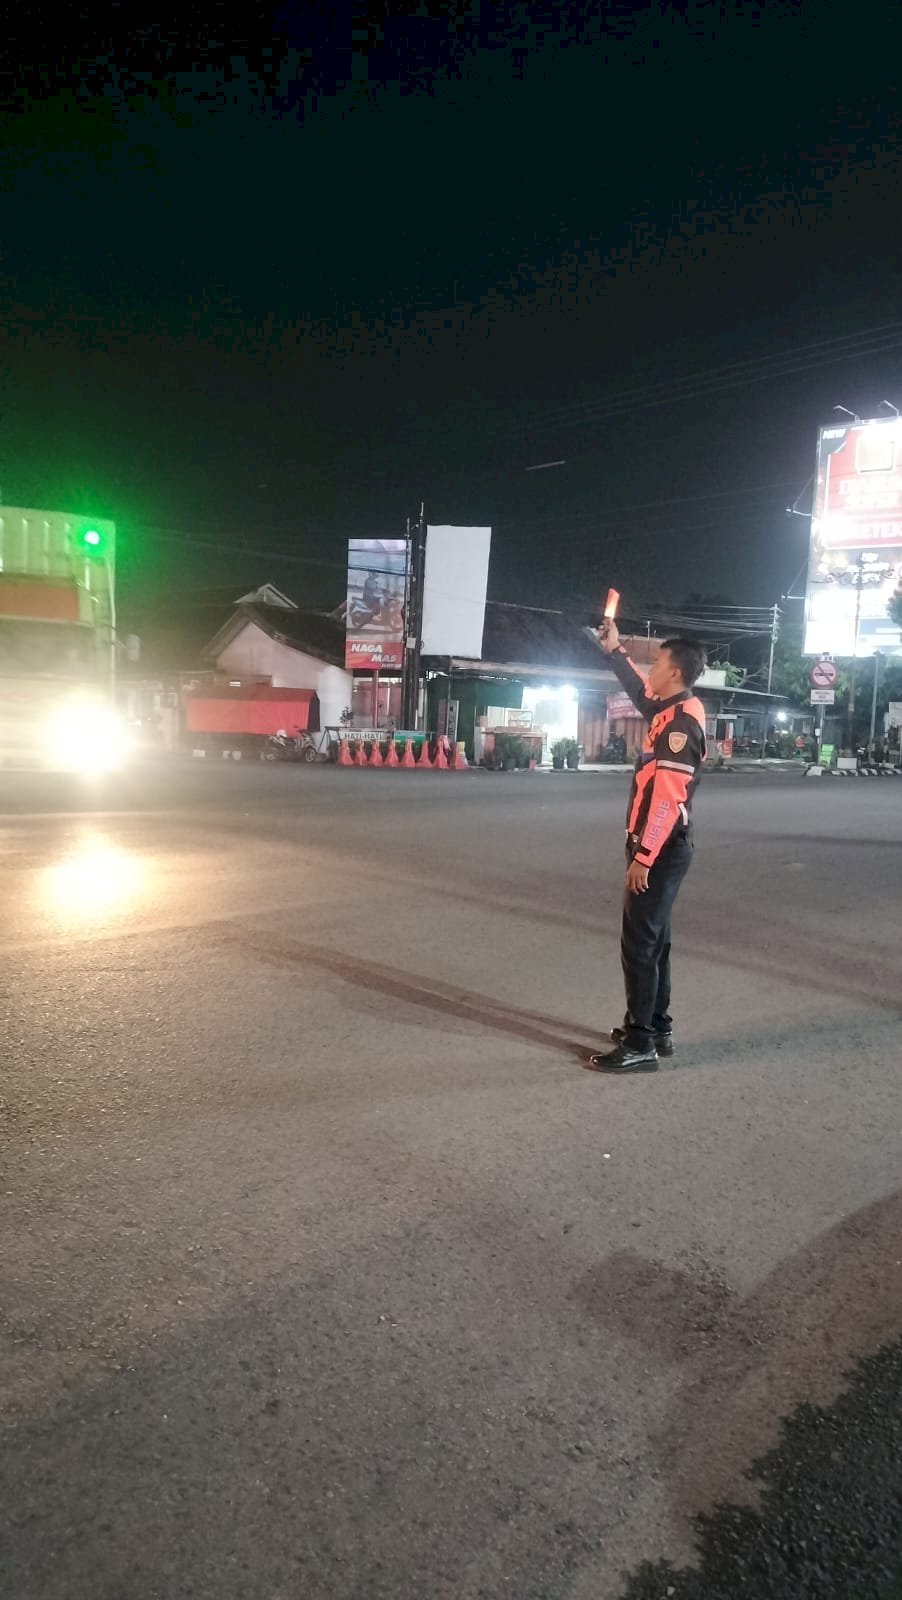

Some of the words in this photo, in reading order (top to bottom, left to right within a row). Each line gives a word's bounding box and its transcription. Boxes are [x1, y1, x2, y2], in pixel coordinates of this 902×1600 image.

[823, 429, 847, 439] NEW
[351, 643, 383, 653] NAGA
[371, 654, 398, 663] MAS
[344, 732, 383, 740] HATI-HATI
[645, 799, 670, 849] DISHUB
